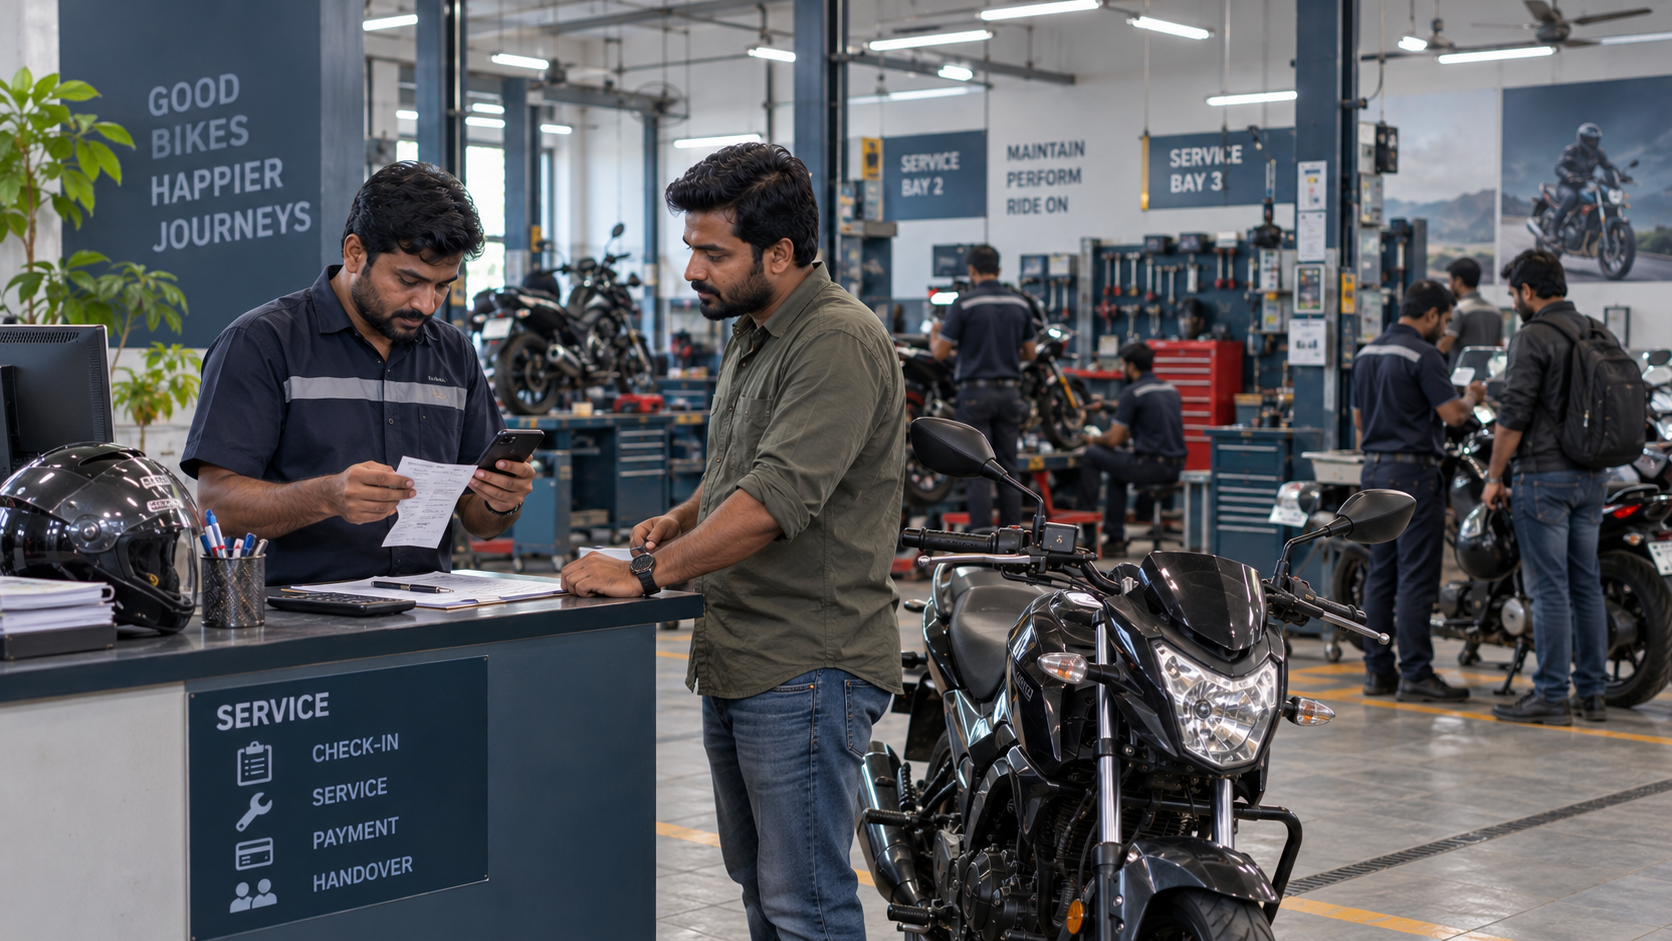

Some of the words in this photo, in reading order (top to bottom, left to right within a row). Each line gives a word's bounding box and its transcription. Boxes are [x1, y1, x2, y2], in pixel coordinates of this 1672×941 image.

[148, 73, 240, 117] GOOD
[151, 115, 249, 160] BIKES
[1006, 139, 1085, 161] MAINTAIN
[900, 151, 960, 173] SERVICE
[1169, 144, 1243, 168] SERVICE
[151, 157, 283, 206] HAPPIER
[901, 177, 931, 197] BAY
[933, 176, 944, 195] 2
[1006, 166, 1082, 188] PERFORM
[1170, 172, 1206, 193] BAY
[1210, 171, 1223, 191] 3
[1006, 197, 1042, 215] RIDE
[1045, 195, 1069, 213] ON
[152, 200, 312, 253] JOURNEYS
[216, 691, 330, 731] SERVICE
[312, 732, 399, 763] CHECK-IN
[312, 776, 388, 807] SERVICE
[313, 816, 400, 850] PAYMENT
[313, 855, 413, 893] HANDOVER
